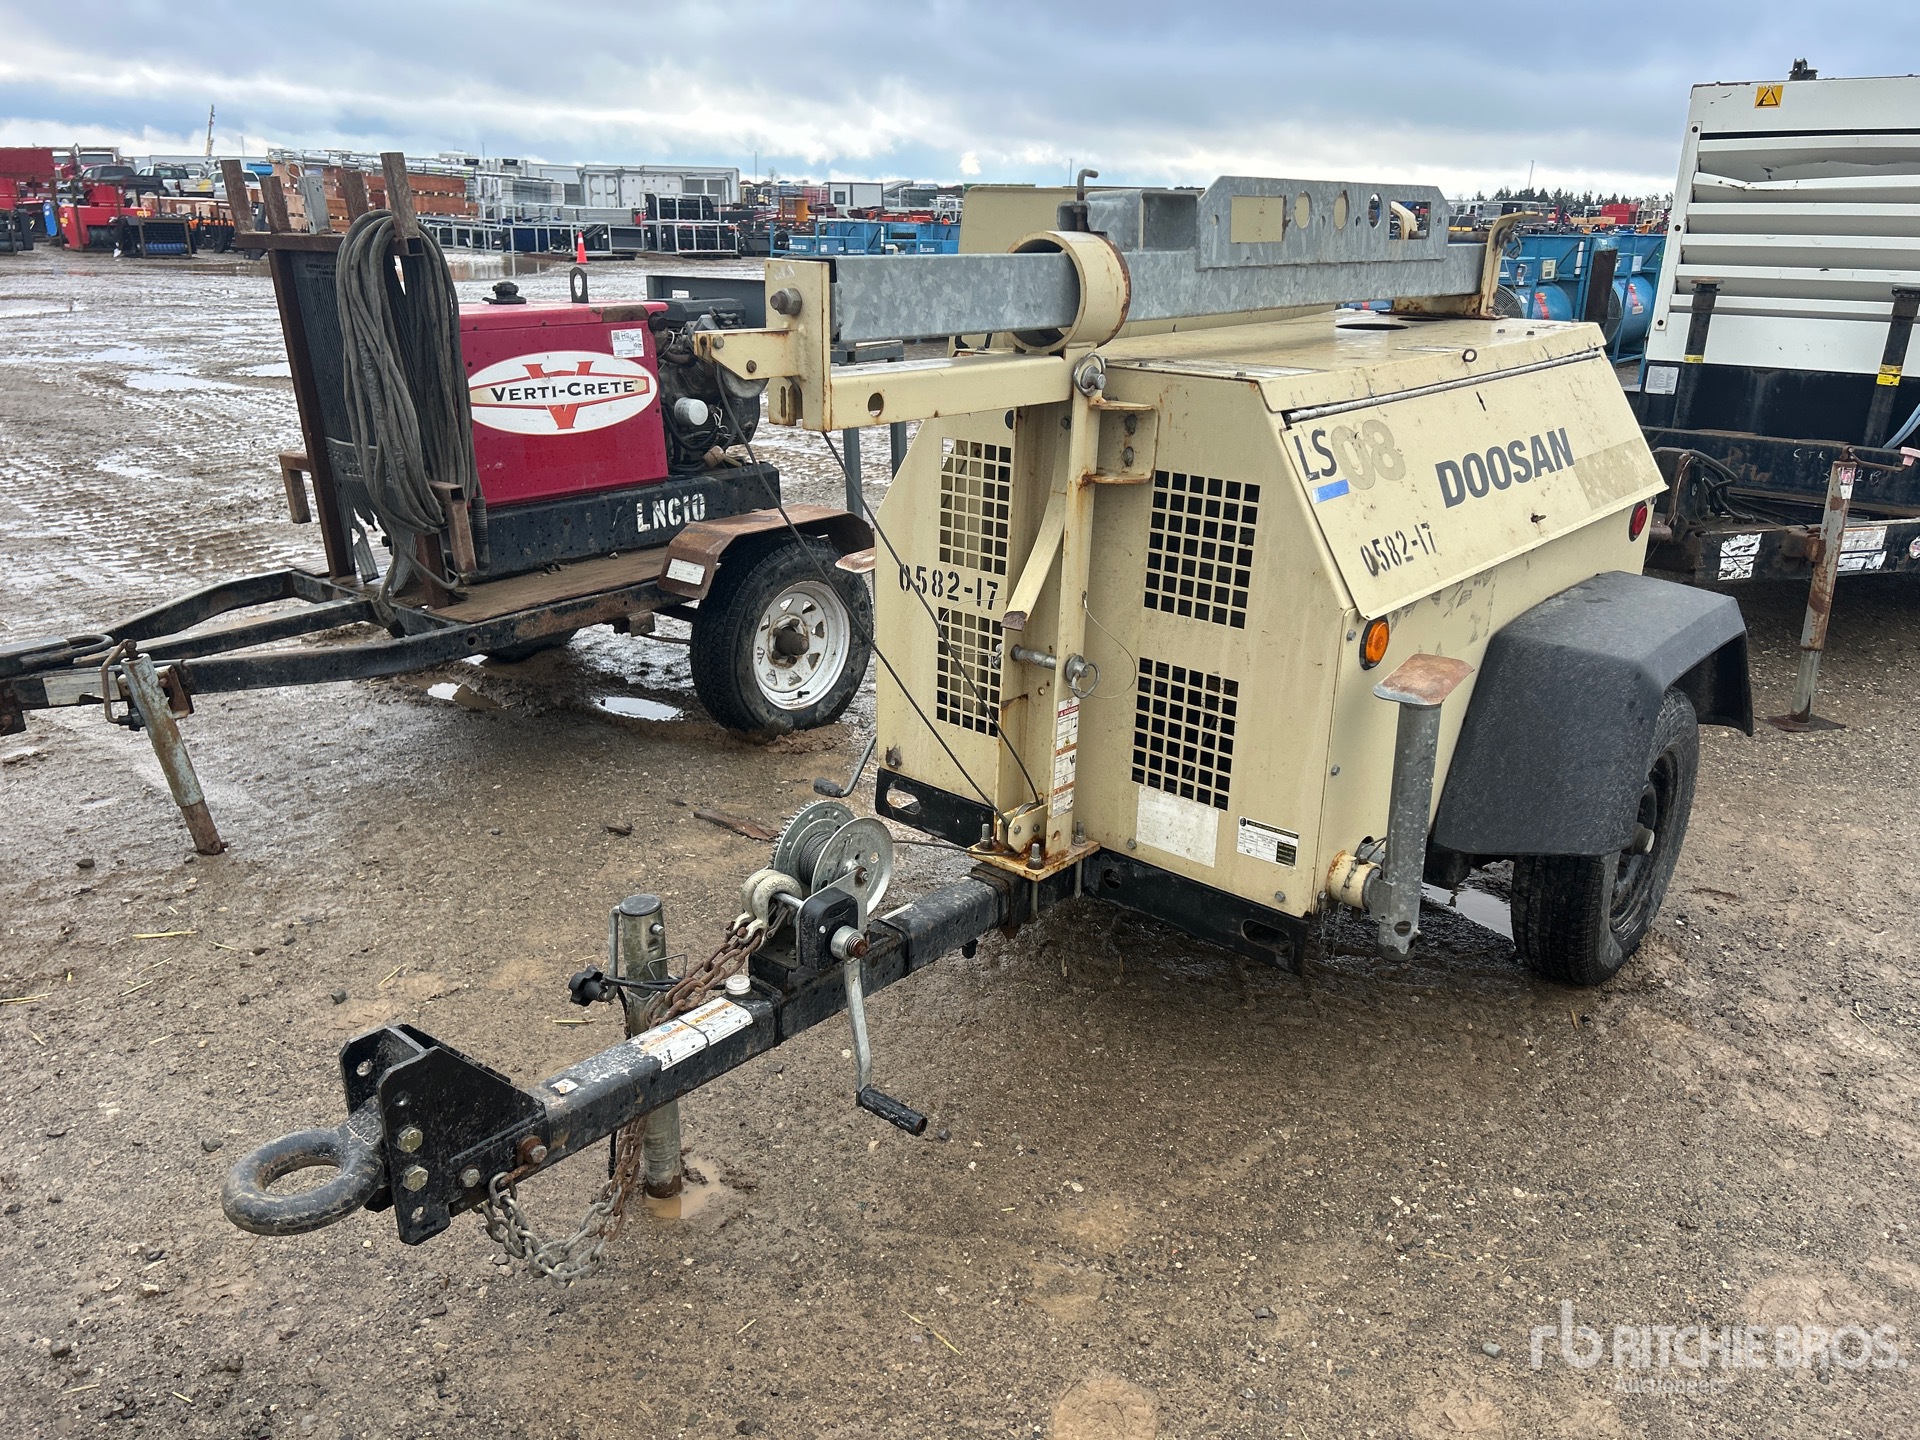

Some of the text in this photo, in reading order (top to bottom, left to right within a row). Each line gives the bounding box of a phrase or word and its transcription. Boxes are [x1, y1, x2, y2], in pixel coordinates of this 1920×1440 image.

[490, 380, 636, 402] VERTI-CRETE
[1434, 426, 1576, 508] DOOSAN
[1360, 522, 1437, 578] 0582-17
[899, 564, 1000, 611] 0582-17
